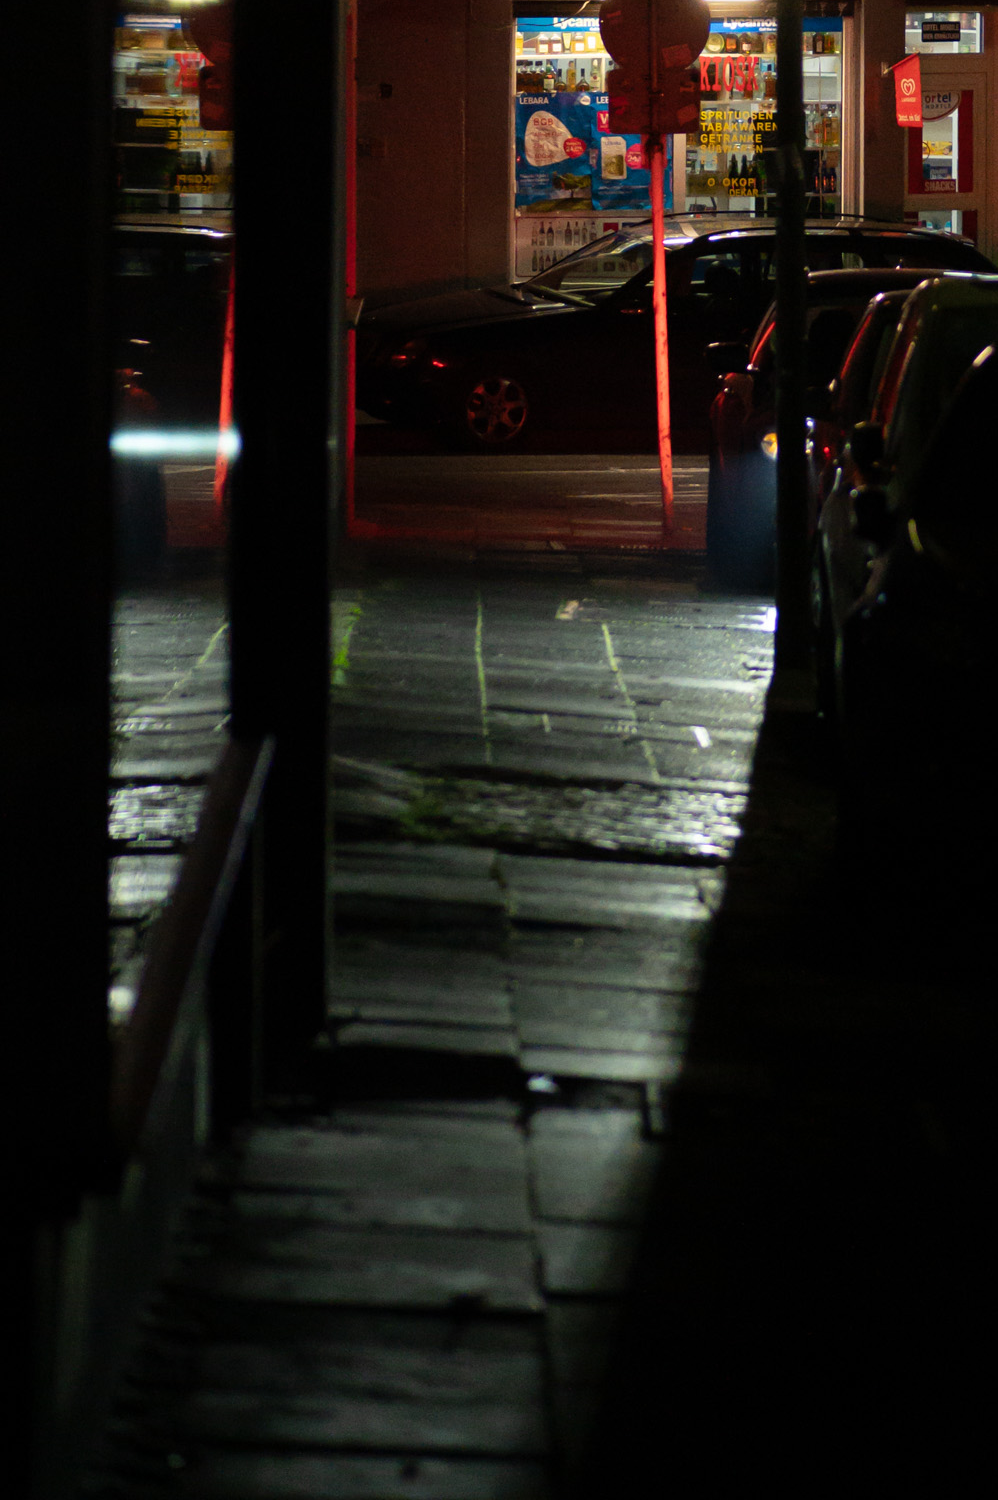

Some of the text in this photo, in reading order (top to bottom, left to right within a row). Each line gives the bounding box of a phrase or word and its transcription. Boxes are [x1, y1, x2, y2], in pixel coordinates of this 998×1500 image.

[553, 17, 600, 30] Lycamo
[699, 55, 760, 92] KIOSK
[519, 97, 549, 105] LEBARA
[925, 92, 952, 103] ortel
[700, 110, 773, 120] SPRITUOSEN
[700, 122, 778, 131] TABAKWAREN
[924, 180, 955, 192] SNACKS
